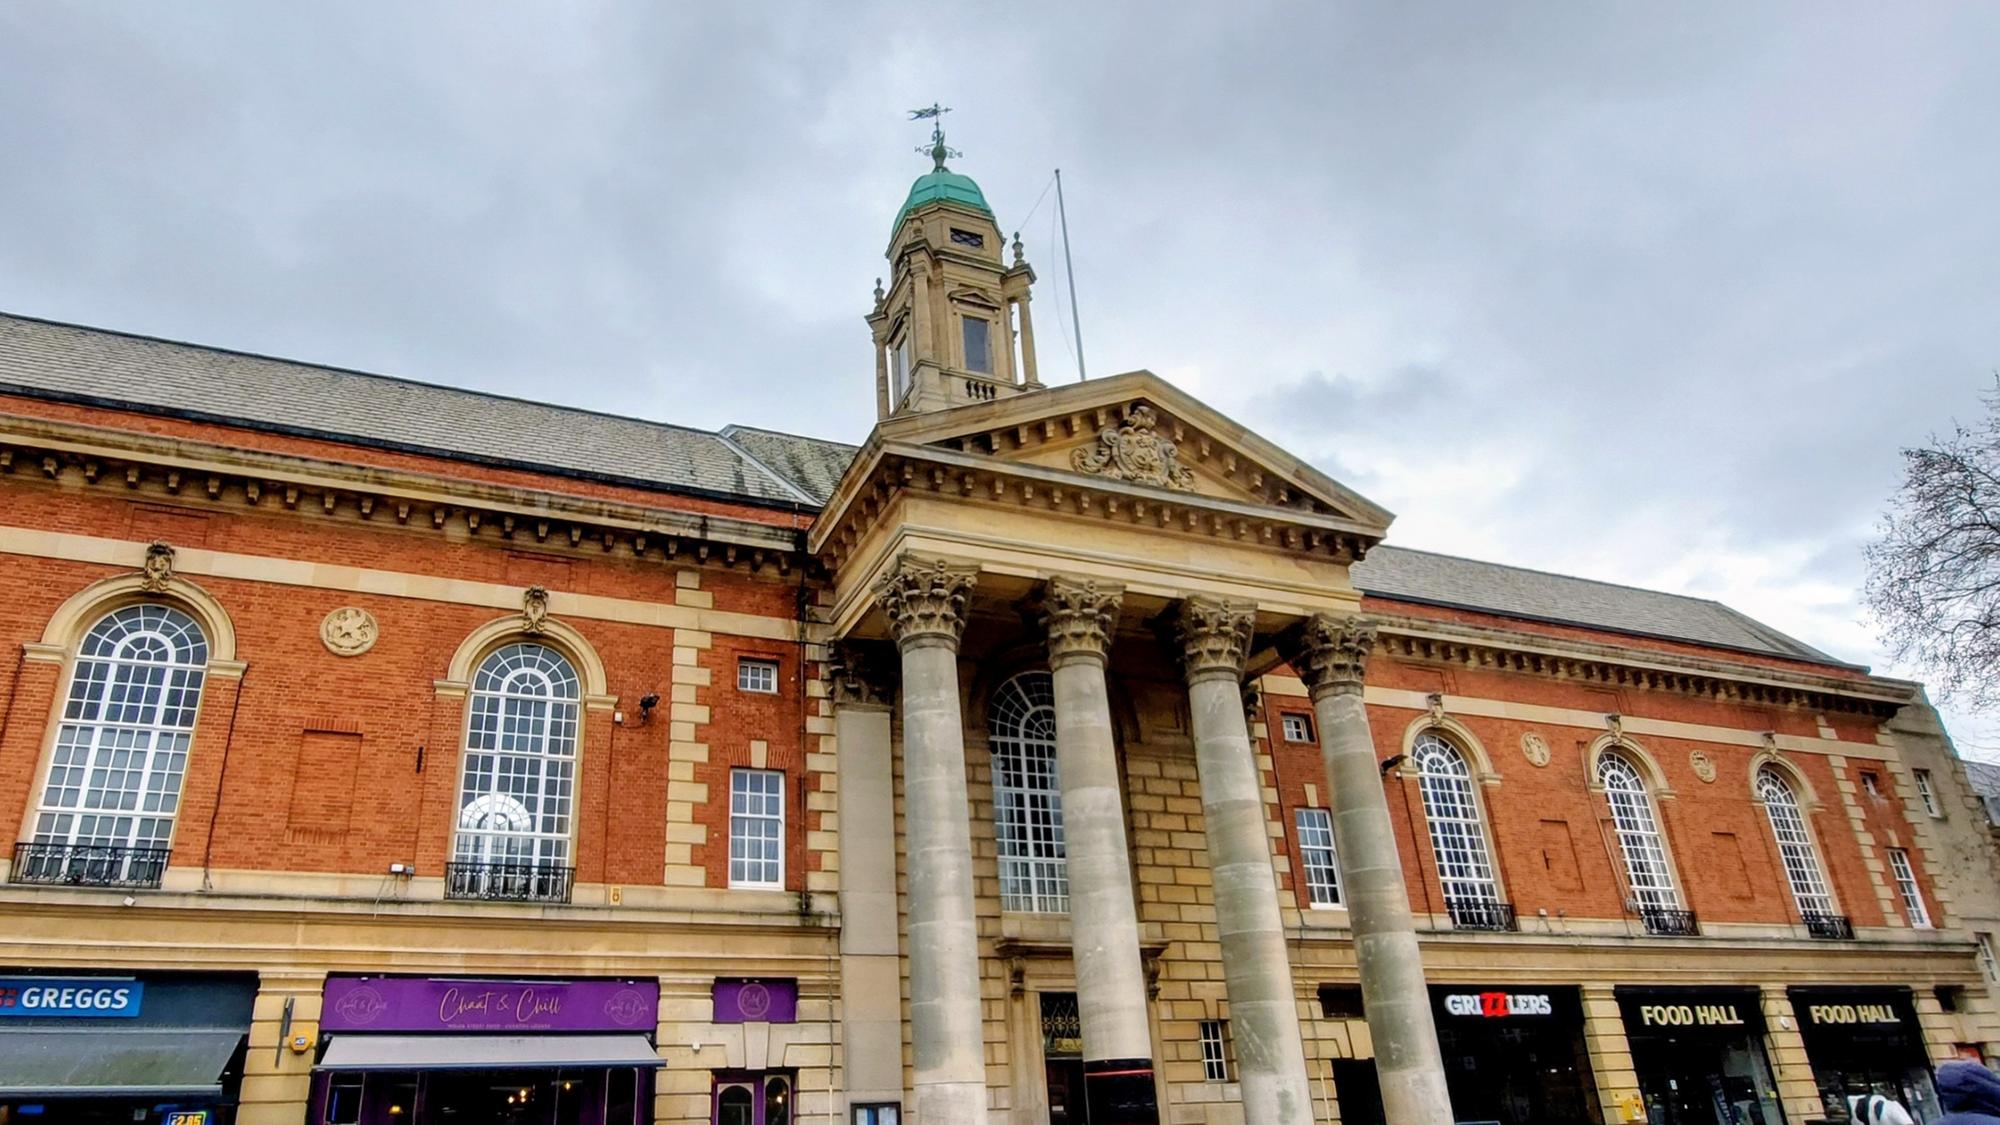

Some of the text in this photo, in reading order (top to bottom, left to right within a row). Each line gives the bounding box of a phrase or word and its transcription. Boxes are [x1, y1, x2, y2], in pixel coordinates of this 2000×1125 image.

[21, 987, 130, 1009] GREGGS
[440, 988, 561, 1022] Chaat & Chill
[1444, 992, 1552, 1017] GRIZZLERS
[1640, 1005, 1744, 1025] FOOD HALL
[1809, 1004, 1901, 1024] FOOD HALL
